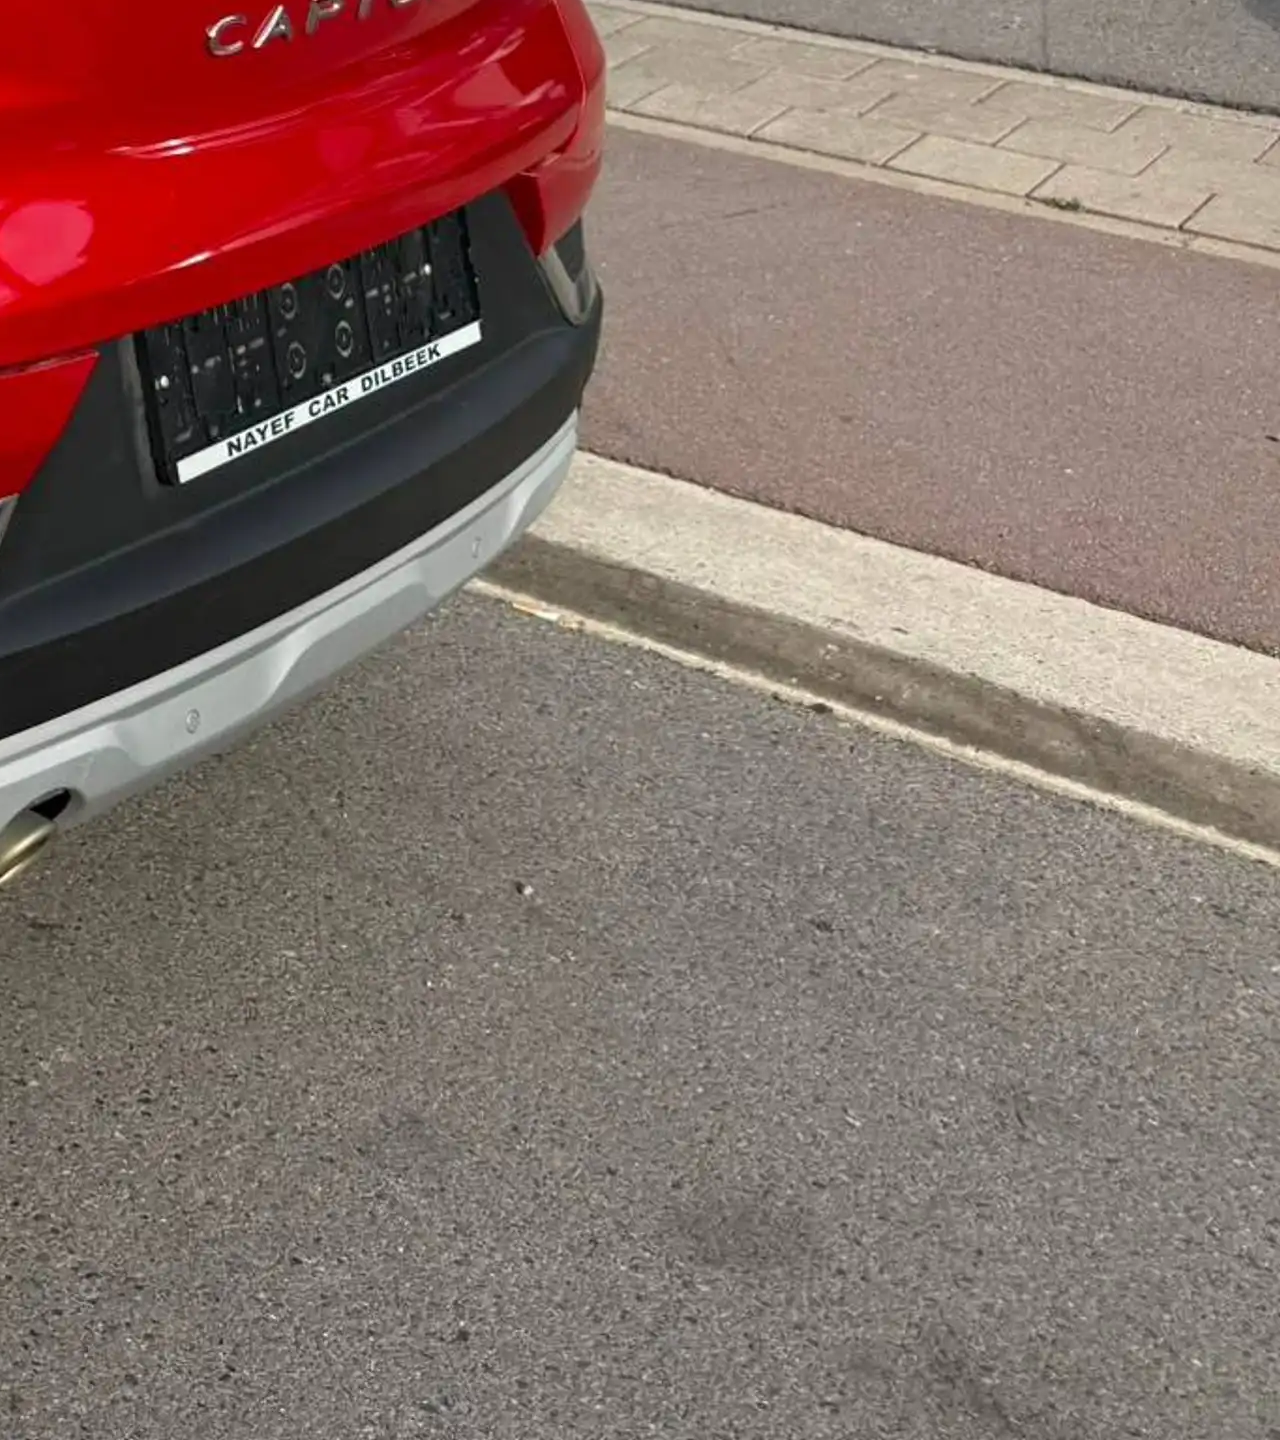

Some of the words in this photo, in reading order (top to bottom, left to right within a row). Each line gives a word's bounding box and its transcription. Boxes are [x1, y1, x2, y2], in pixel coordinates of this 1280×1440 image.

[226, 411, 297, 457] NAYEF
[308, 387, 350, 418] CAR
[360, 343, 442, 393] DILBEEK
